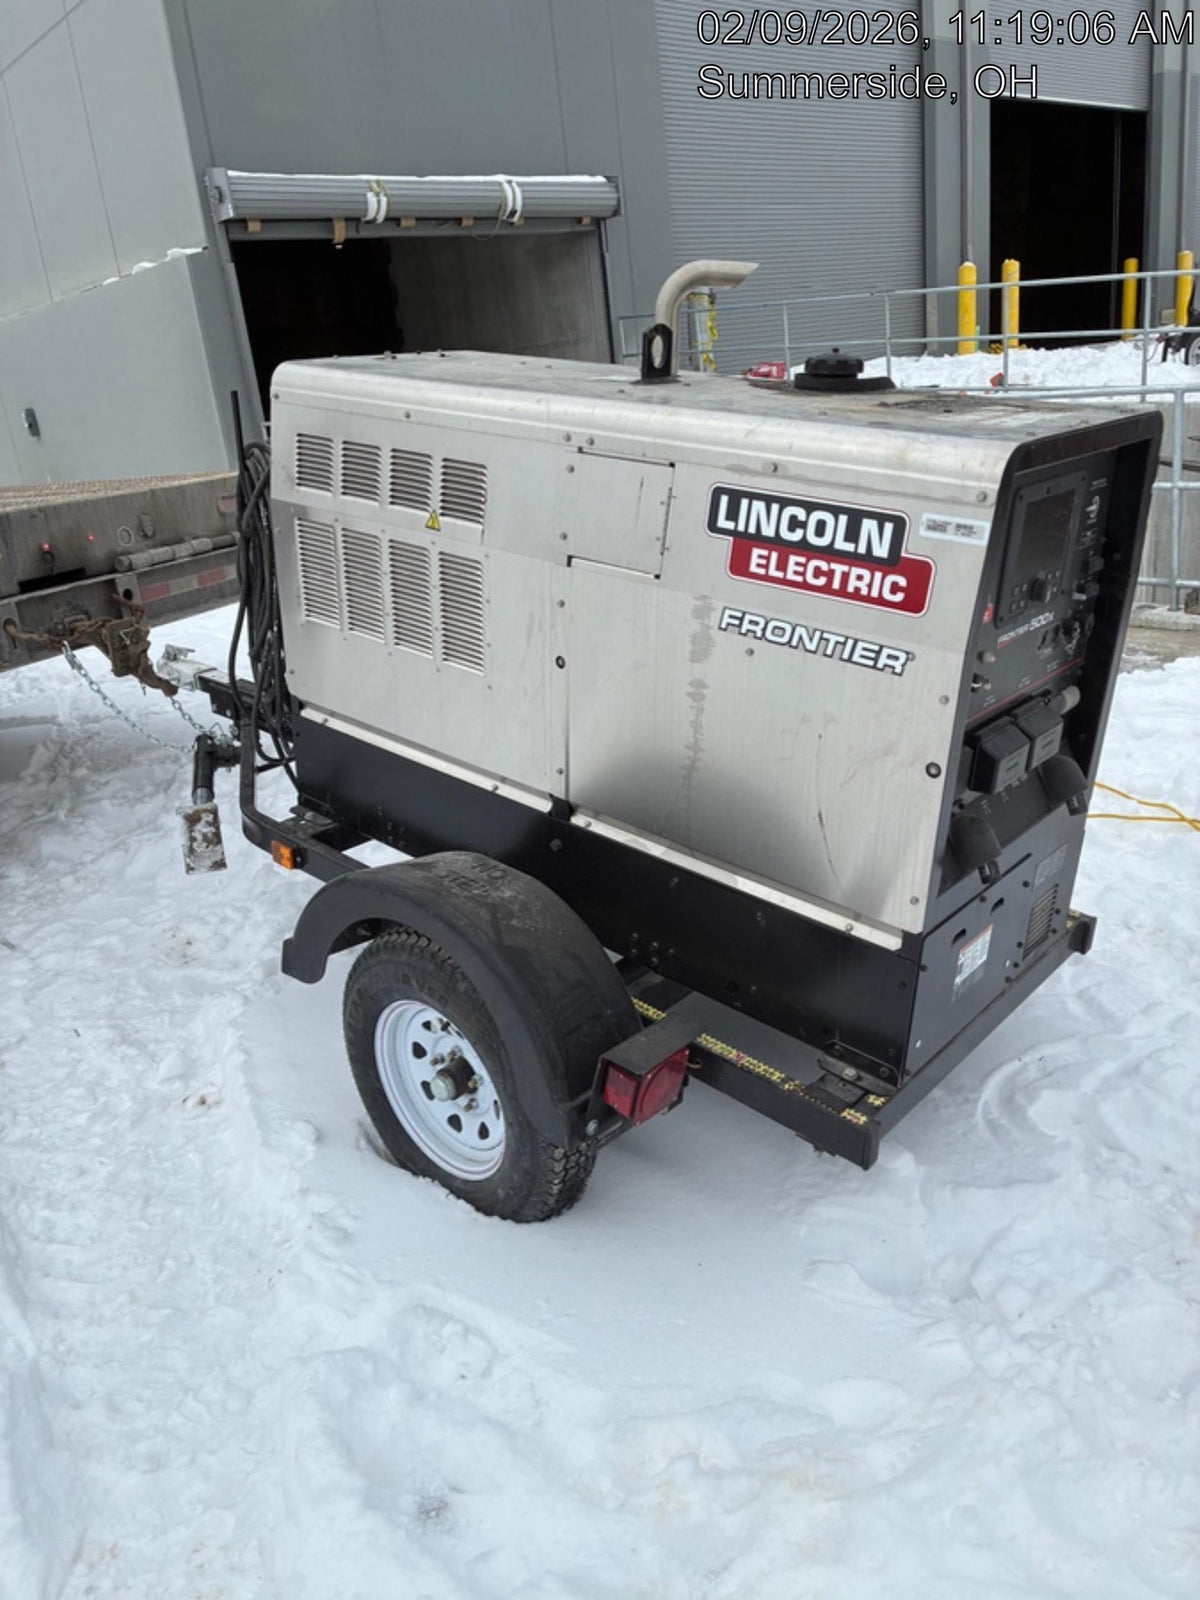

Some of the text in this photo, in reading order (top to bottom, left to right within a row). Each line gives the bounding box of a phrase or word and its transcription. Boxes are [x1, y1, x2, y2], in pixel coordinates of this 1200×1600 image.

[715, 493, 895, 560] LINCOLN
[748, 546, 908, 603] ELECTRIC
[719, 606, 910, 676] FRONTIER
